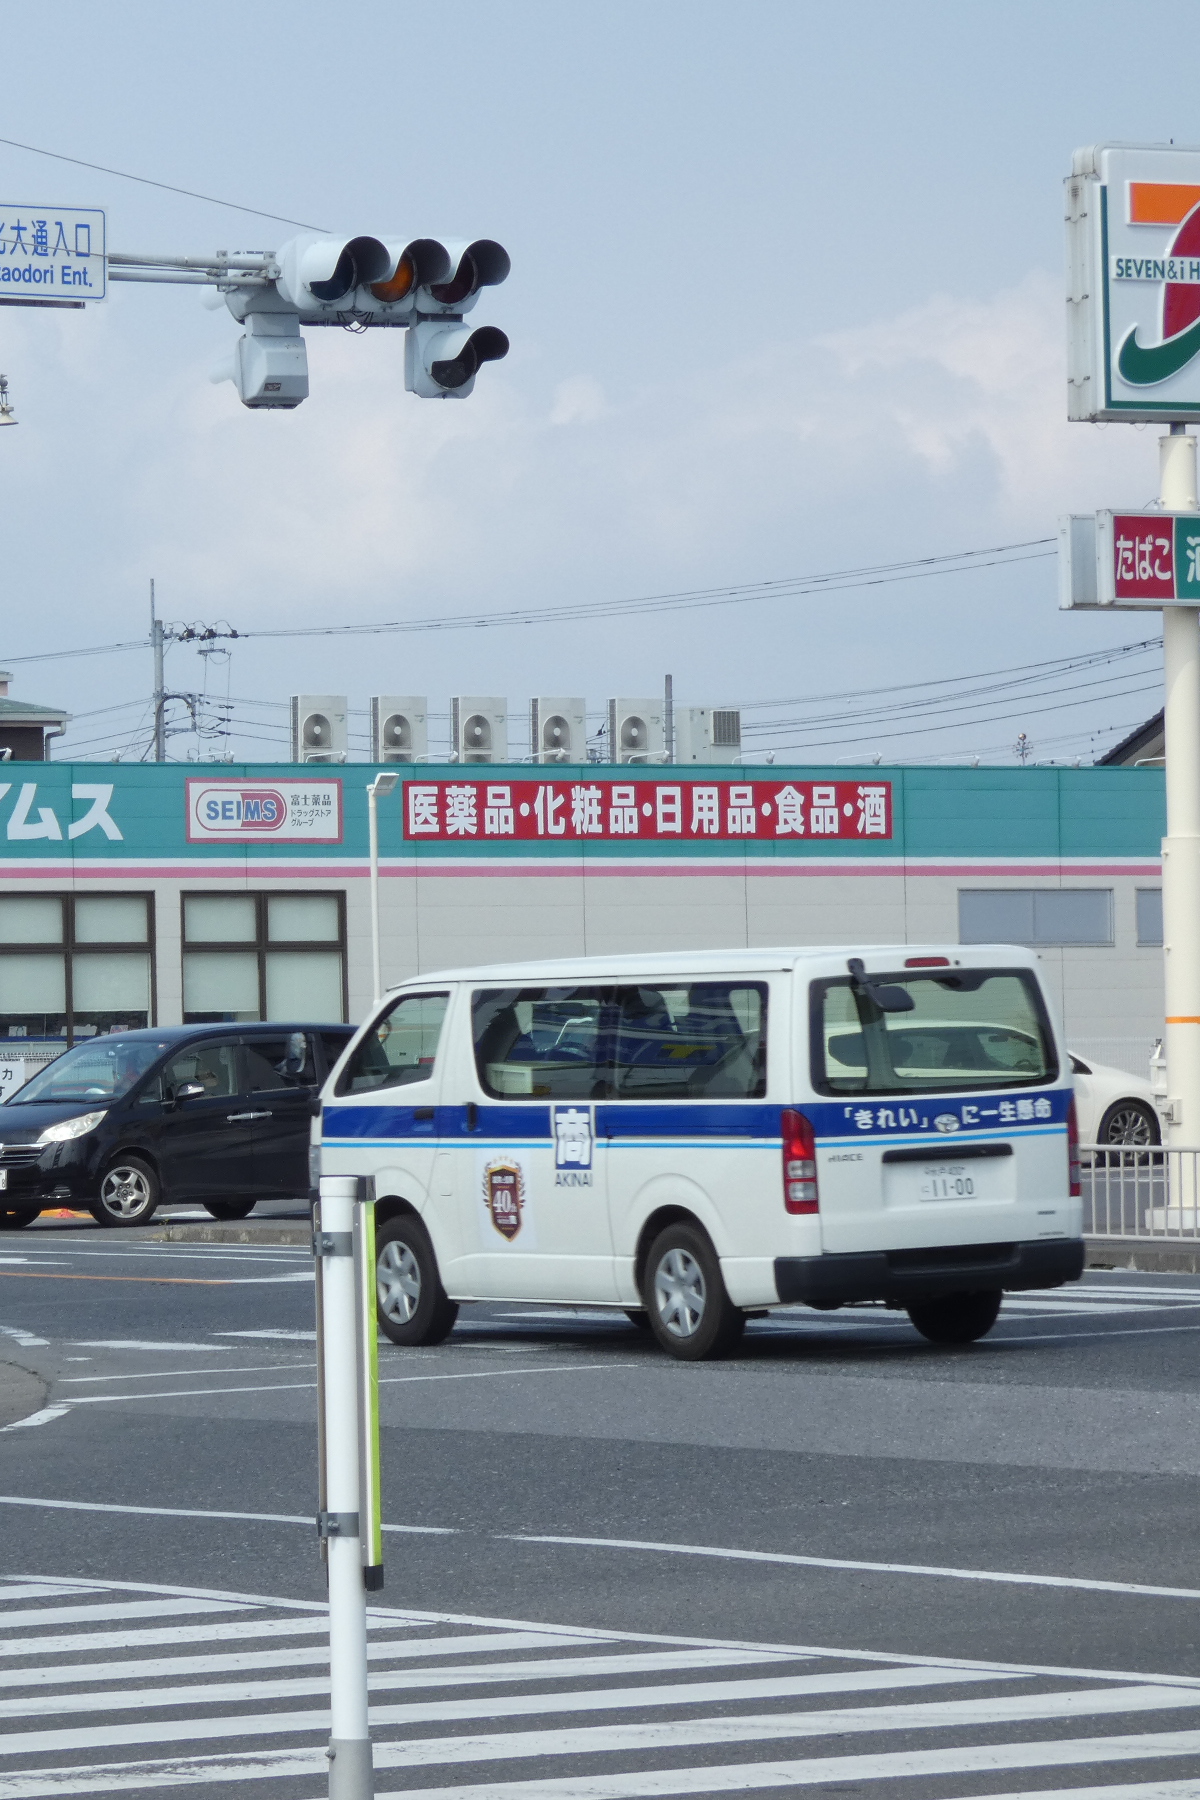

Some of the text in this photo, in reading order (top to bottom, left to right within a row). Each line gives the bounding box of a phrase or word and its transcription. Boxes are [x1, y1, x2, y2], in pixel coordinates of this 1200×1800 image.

[61, 265, 93, 288] Ent.
[1116, 534, 1172, 581] たばこ
[206, 800, 278, 822] SEIMS
[290, 794, 332, 807] 富士薬品
[408, 785, 887, 835] 医薬品・化粧品・日用品・食品・酒
[290, 808, 332, 818] ドラッグストア
[290, 818, 315, 828] グループ
[961, 1098, 1052, 1125] に一生懸命
[555, 1172, 593, 1187] AKINAI
[932, 1177, 974, 1197] 11-00
